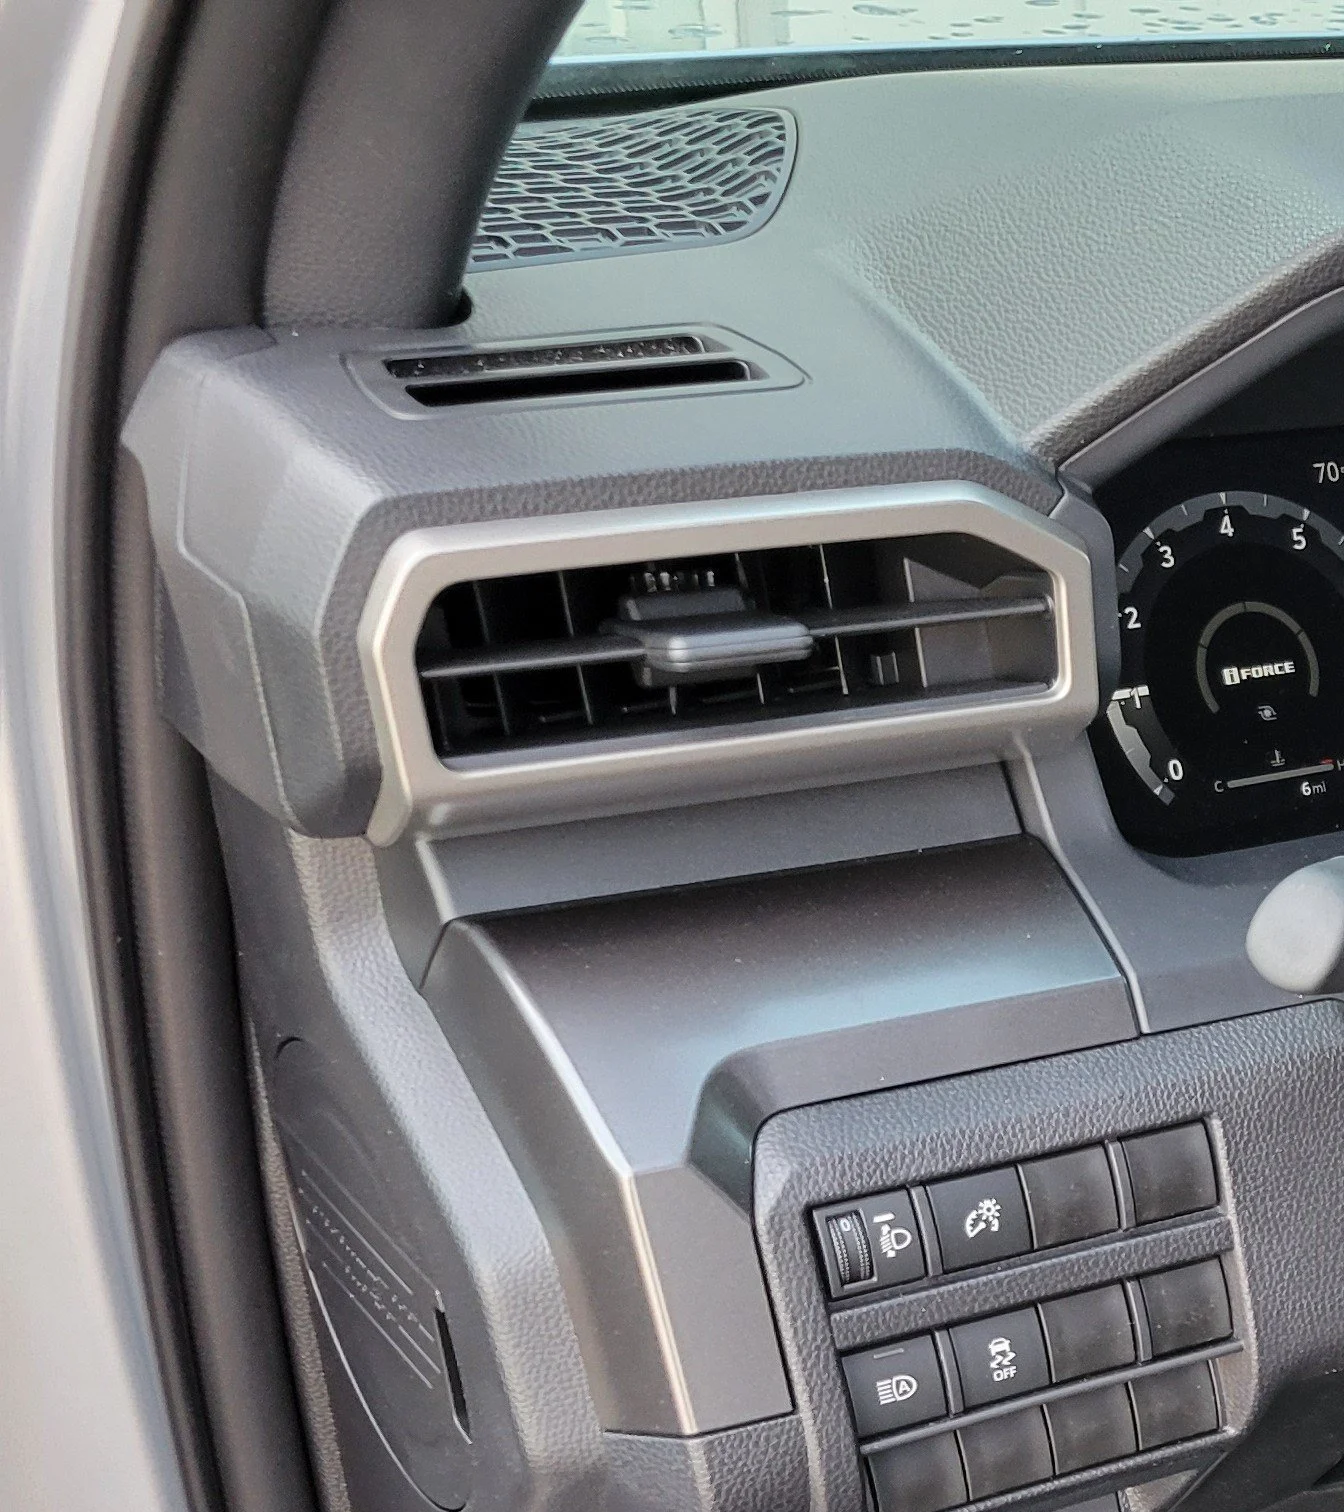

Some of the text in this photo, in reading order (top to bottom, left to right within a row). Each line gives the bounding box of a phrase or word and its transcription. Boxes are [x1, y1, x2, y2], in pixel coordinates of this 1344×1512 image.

[1219, 515, 1234, 537] 4
[1292, 528, 1307, 551] 5
[1160, 546, 1175, 568] 3
[1124, 607, 1142, 629] 2
[1131, 687, 1142, 709] 1
[1168, 759, 1184, 781] 0
[1214, 780, 1224, 793] C
[992, 1364, 1018, 1382] OFF
